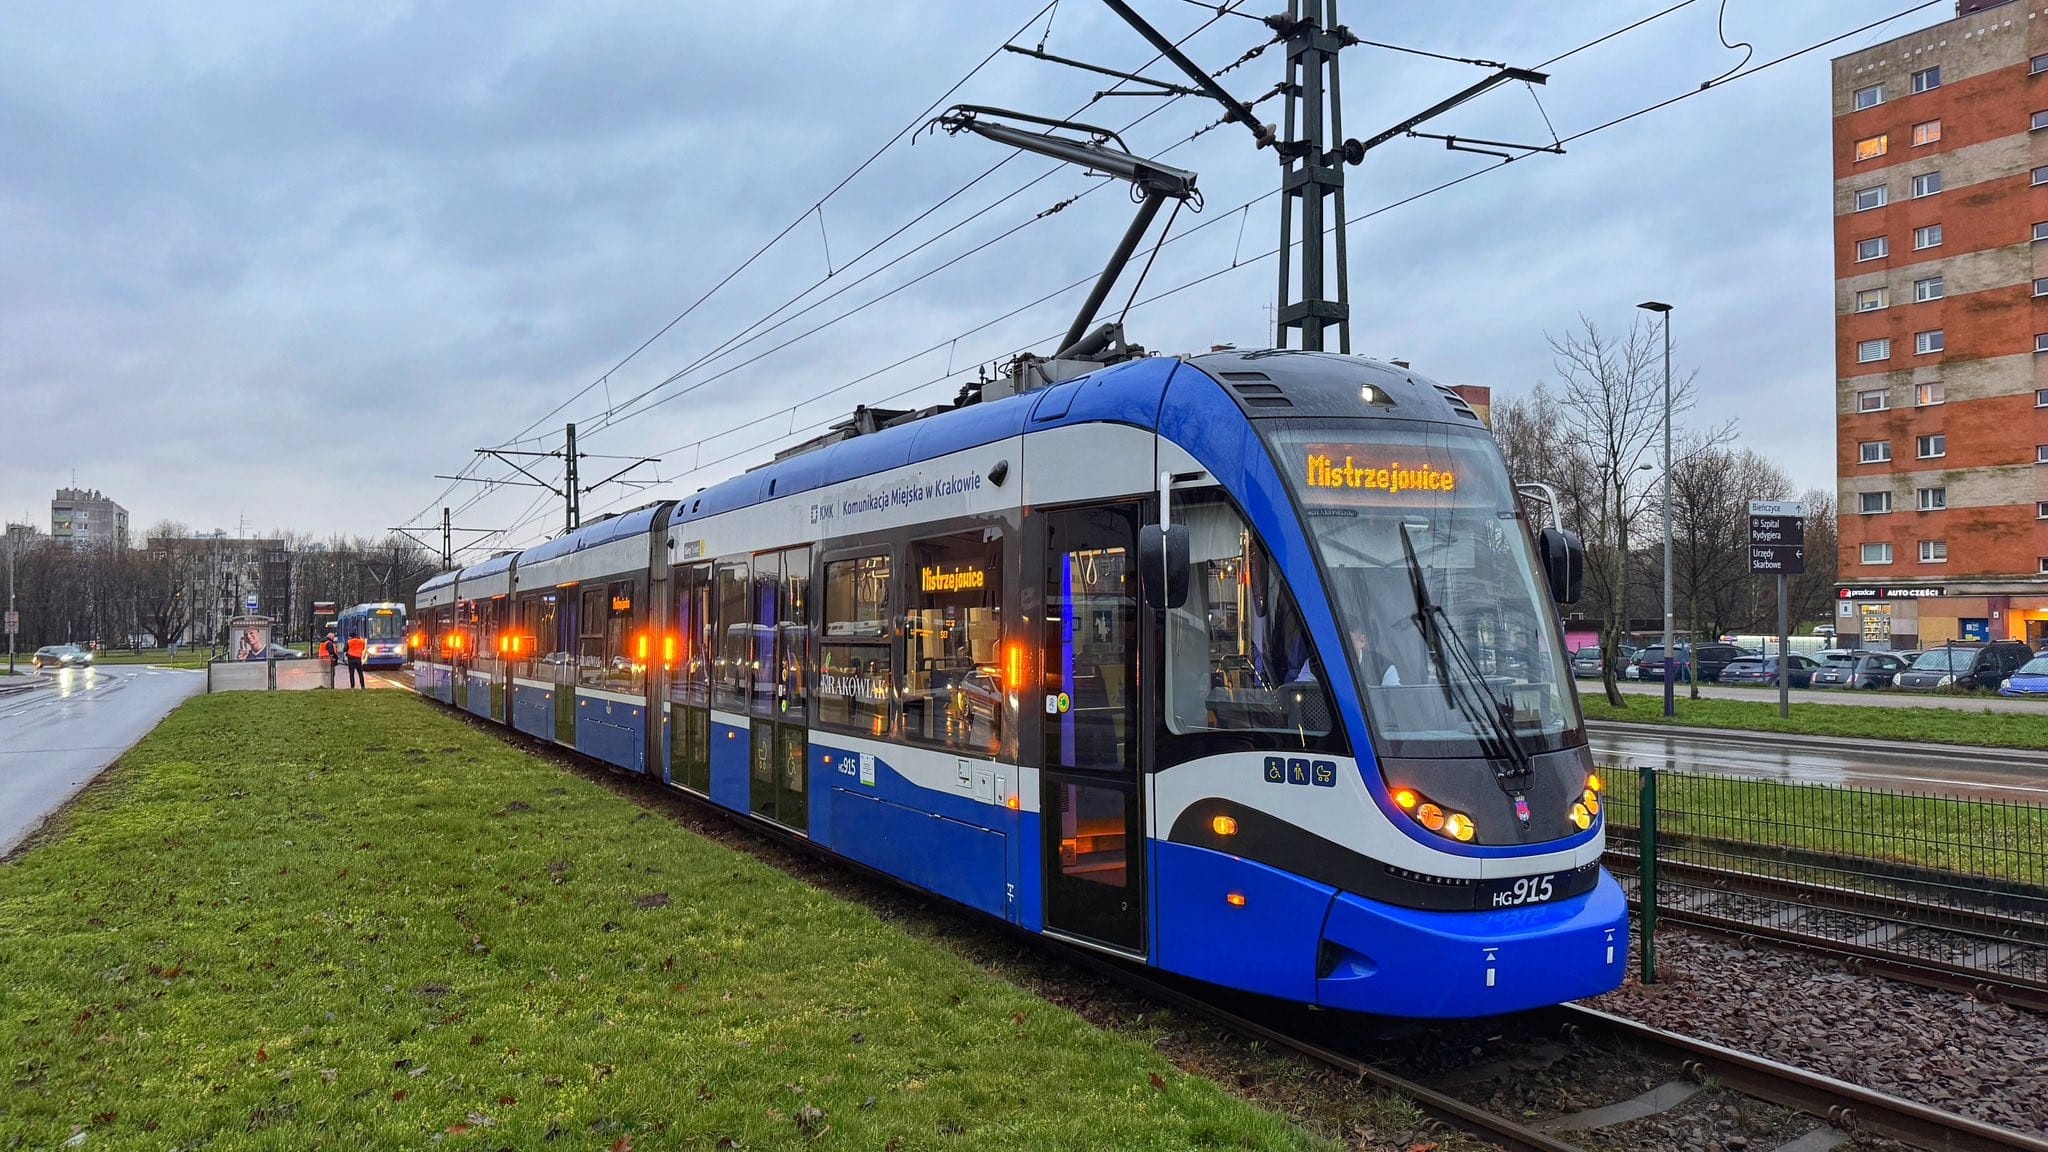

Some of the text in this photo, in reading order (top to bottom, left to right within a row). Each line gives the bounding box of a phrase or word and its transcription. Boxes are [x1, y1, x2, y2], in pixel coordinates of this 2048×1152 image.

[1307, 454, 1455, 493] Mistrzejowice
[819, 470, 981, 521] KMK Komunikacja Miejska w Krakowie
[1752, 502, 1781, 514] Bieńczyce
[1760, 519, 1780, 530] Szpital
[1752, 530, 1781, 541] Rydygiera
[1752, 548, 1774, 560] Urzędy
[1752, 560, 1781, 569] Skarbowe
[922, 565, 984, 593] Mistrzejowice
[1886, 589, 1908, 597] AUTO
[821, 674, 886, 700] KRAKOWIAK
